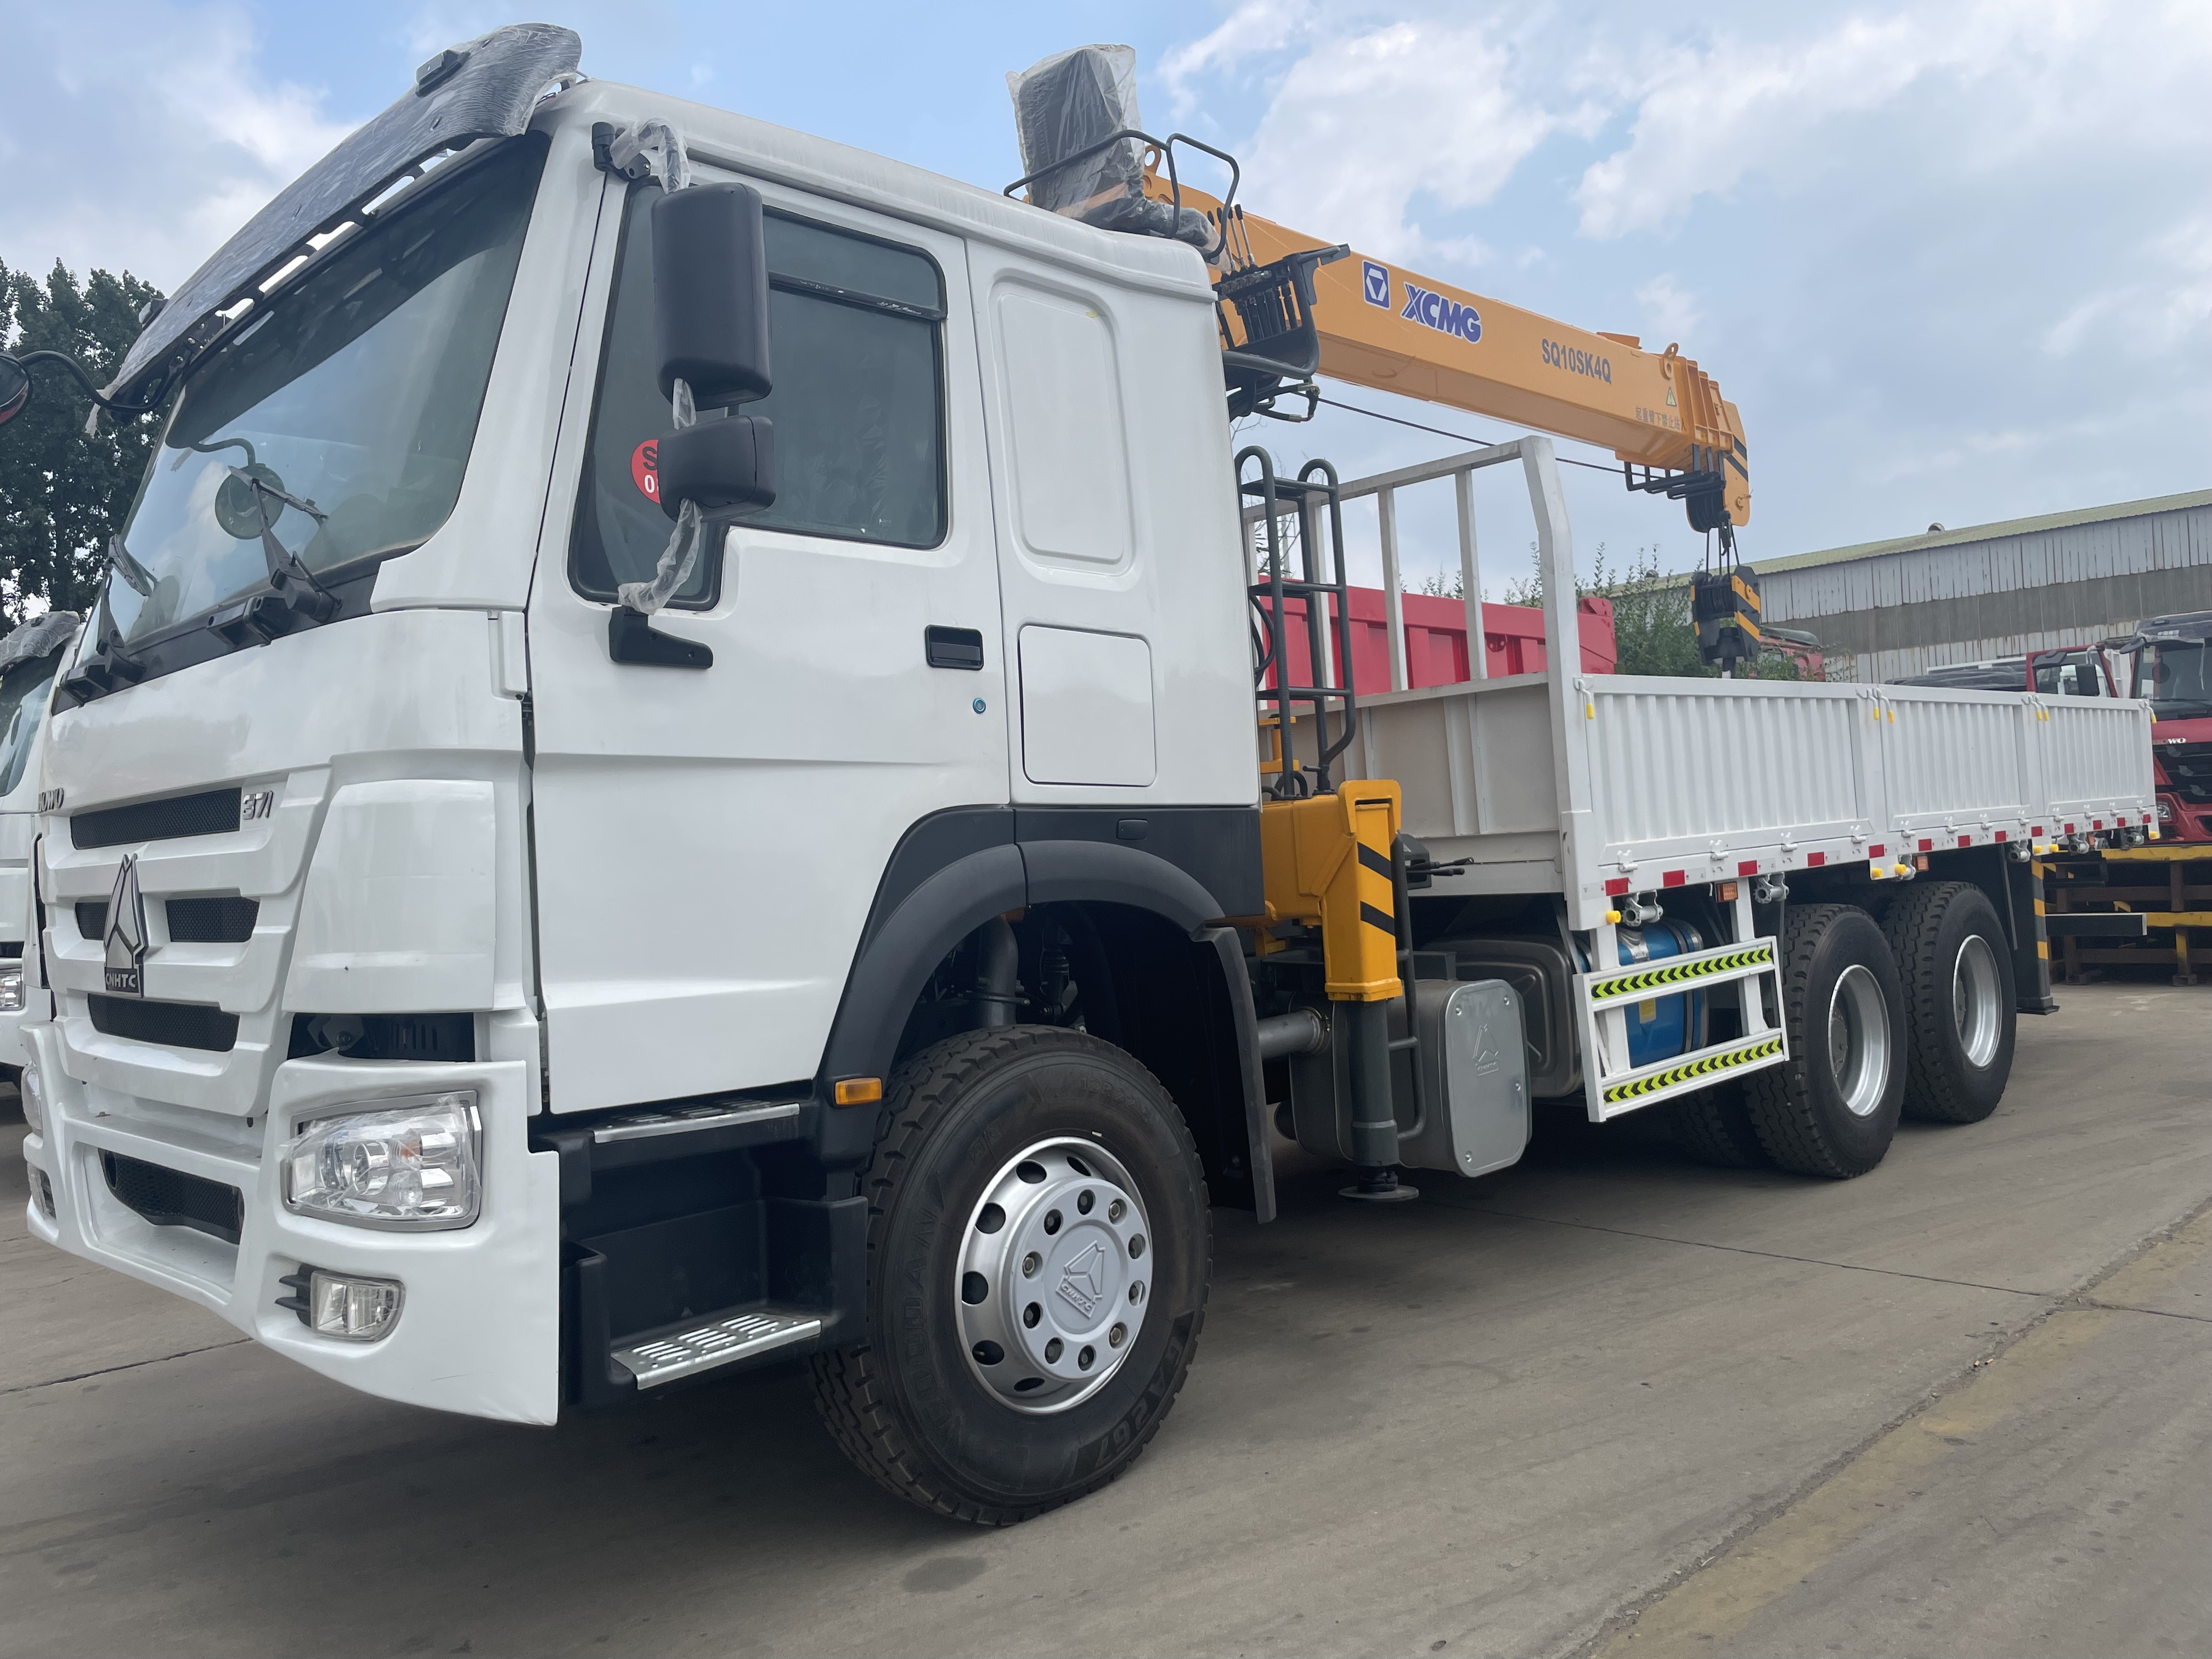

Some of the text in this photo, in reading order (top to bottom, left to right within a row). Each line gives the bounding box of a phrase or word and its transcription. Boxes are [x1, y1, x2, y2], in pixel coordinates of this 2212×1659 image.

[1400, 282, 1482, 343] XCMG
[1542, 338, 1611, 385] SQ10SK4Q
[242, 790, 274, 820] 371
[105, 973, 136, 988] CNHTC
[1060, 1284, 1092, 1311] CNHTC
